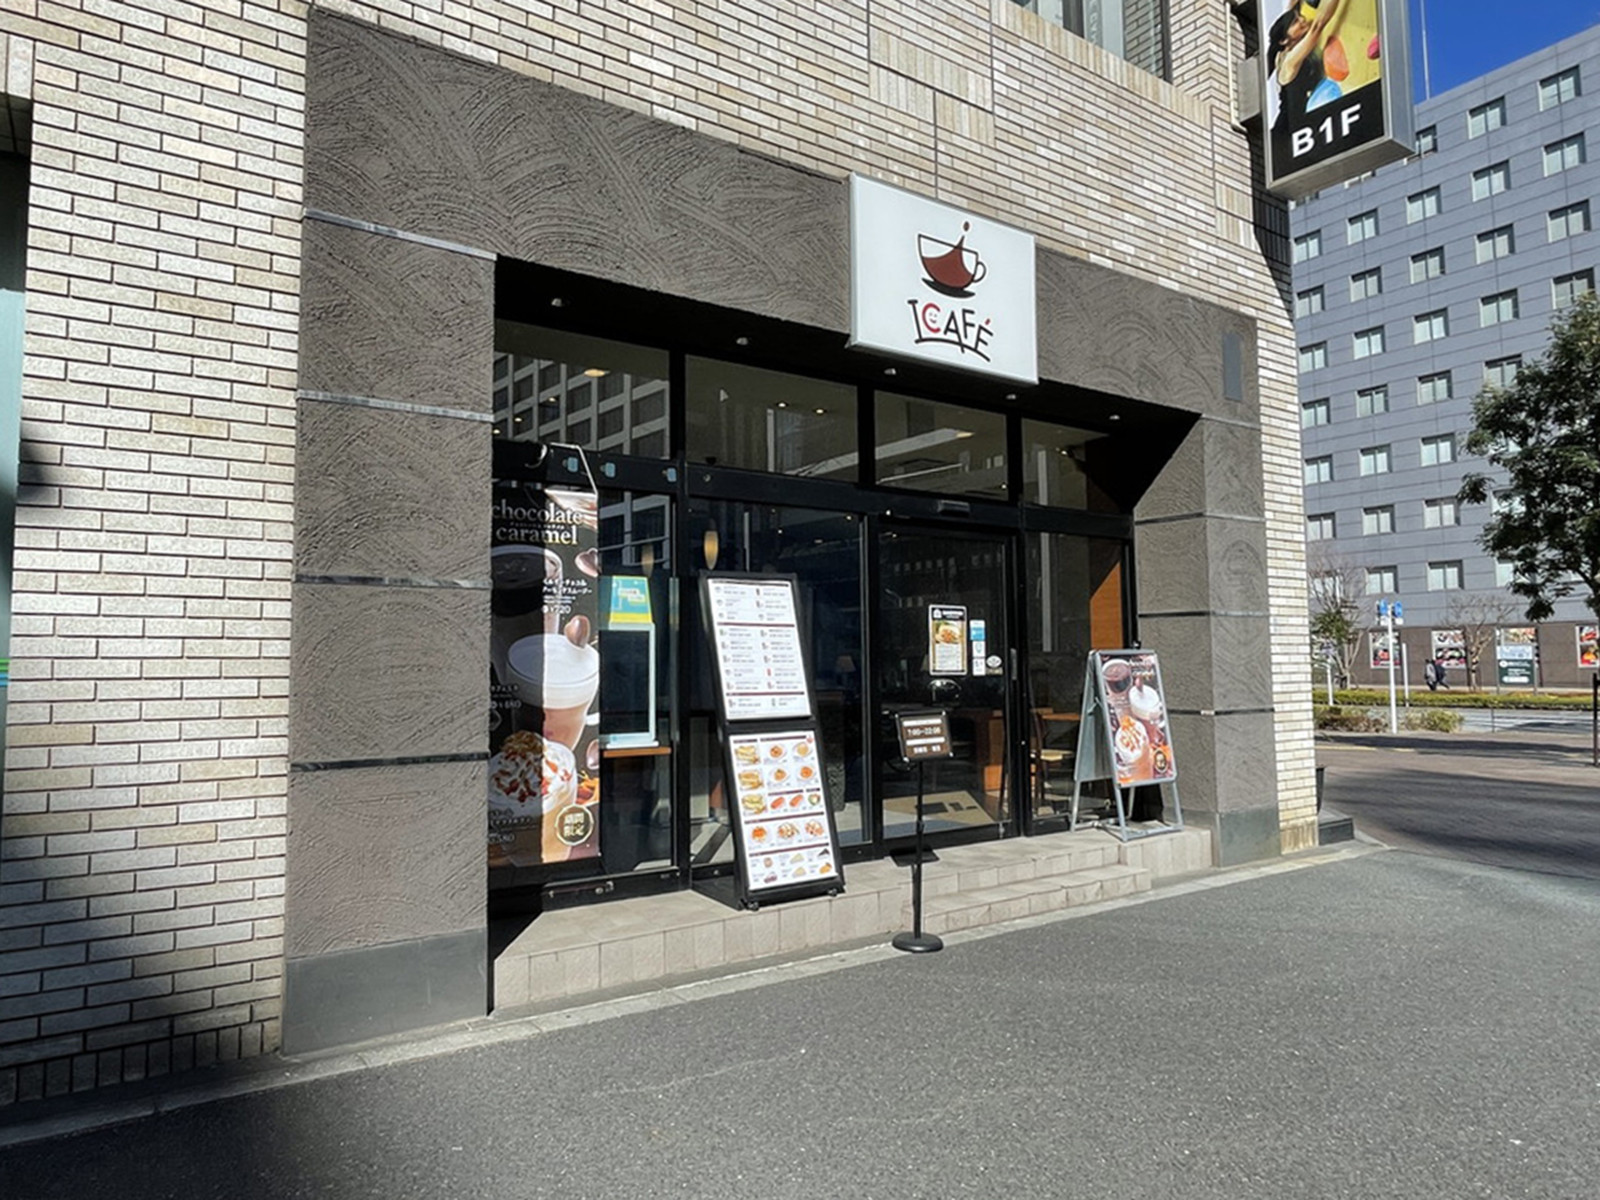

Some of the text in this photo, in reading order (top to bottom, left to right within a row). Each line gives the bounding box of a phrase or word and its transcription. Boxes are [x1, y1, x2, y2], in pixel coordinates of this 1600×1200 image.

[1291, 103, 1361, 158] B1F
[492, 499, 583, 525] chocolate
[496, 525, 578, 545] caramel
